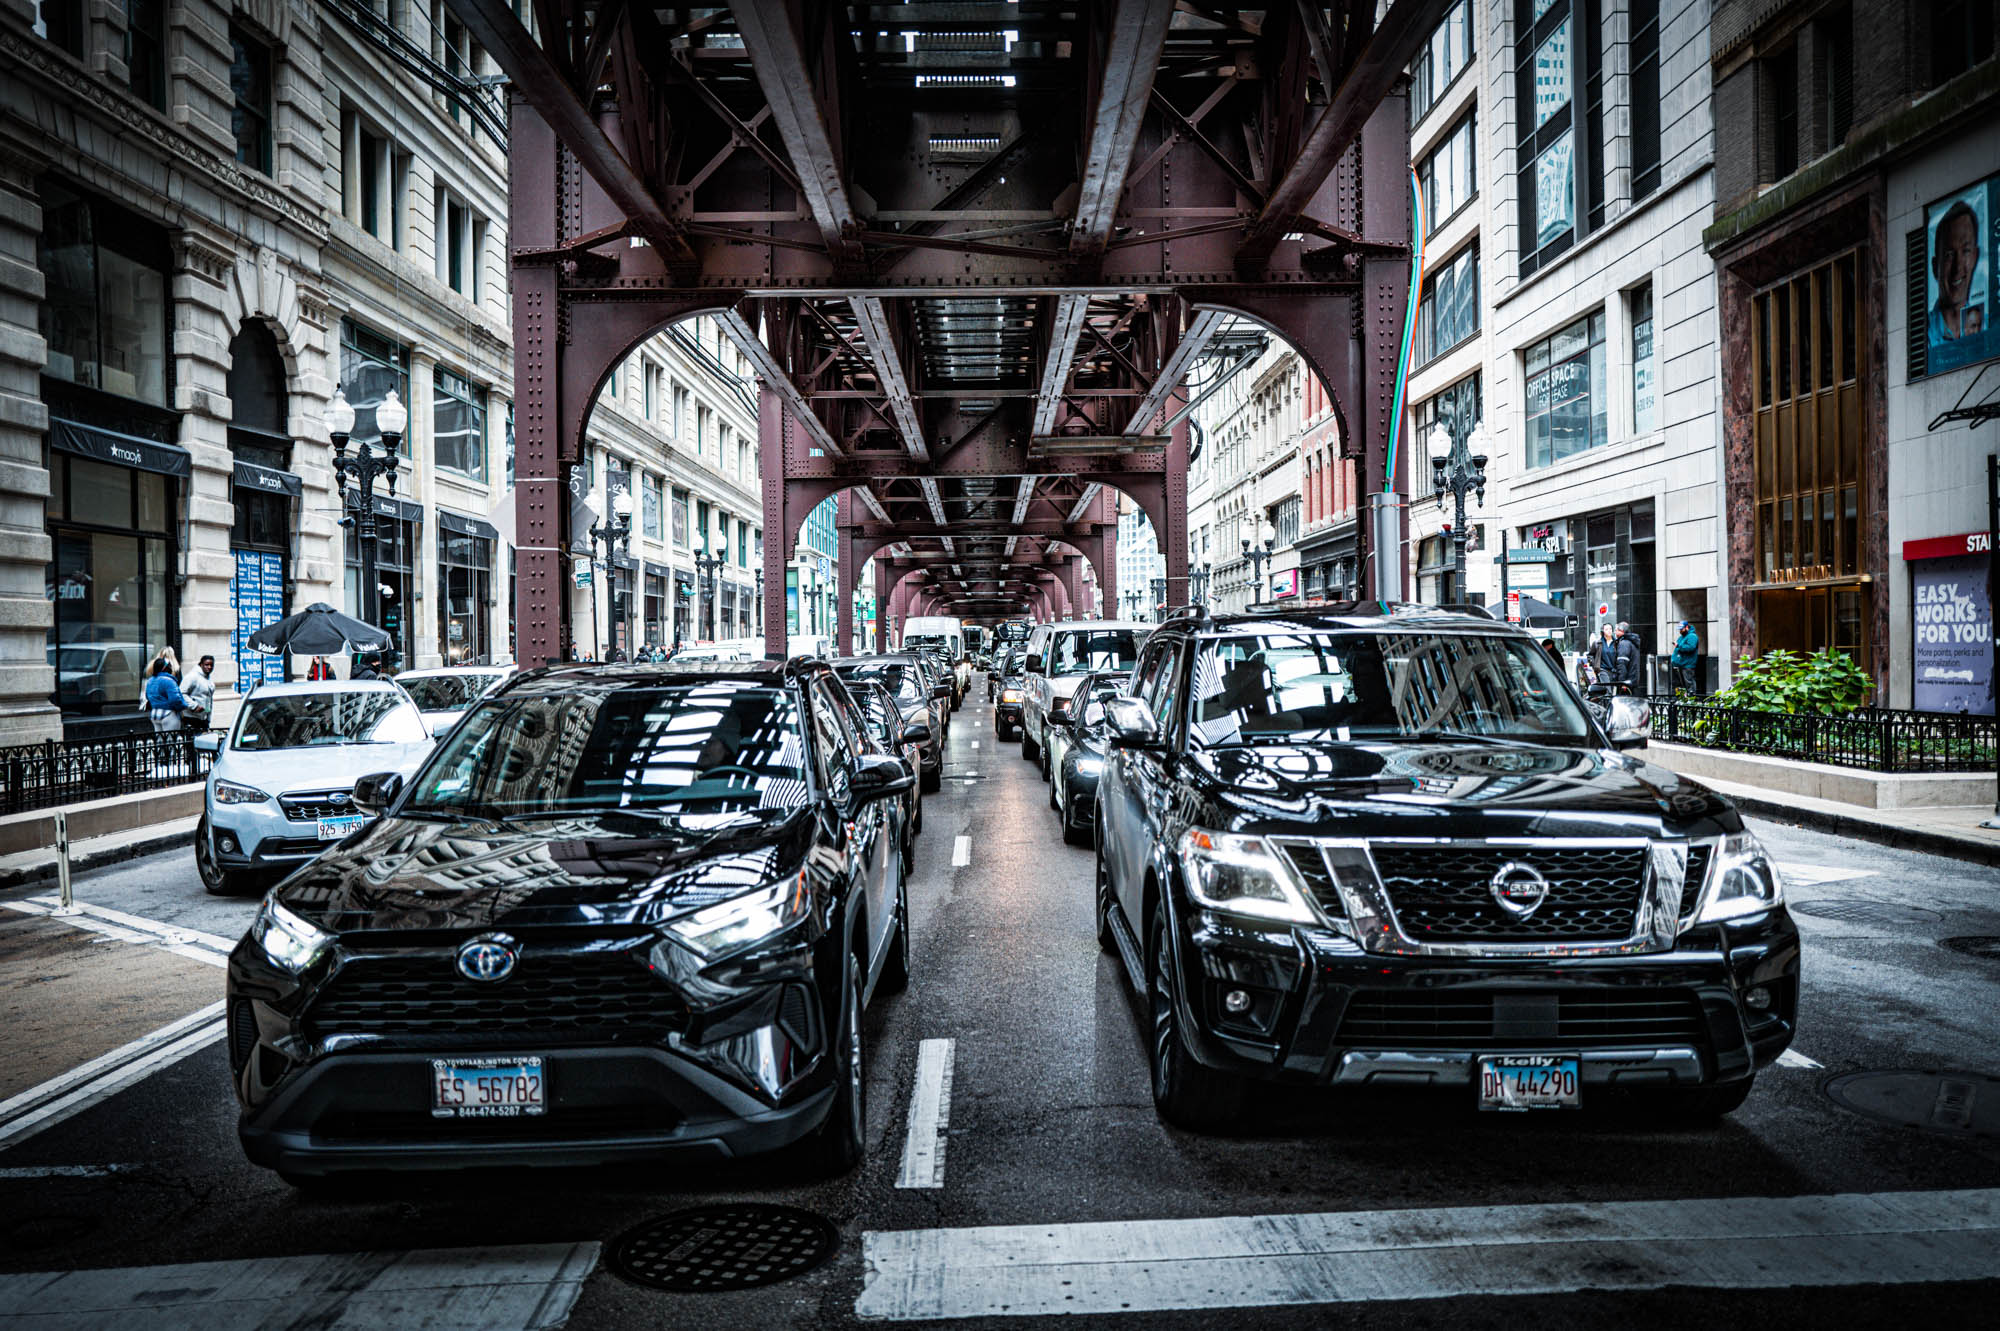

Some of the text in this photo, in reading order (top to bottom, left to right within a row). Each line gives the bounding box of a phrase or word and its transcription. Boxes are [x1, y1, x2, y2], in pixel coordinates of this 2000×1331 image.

[1526, 362, 1575, 399] OFFICE SPACE
[116, 449, 142, 465] macy's
[262, 476, 282, 489] macy's
[1545, 535, 1561, 554] SPA
[1916, 583, 1959, 604] EASY
[1915, 602, 1977, 624] WORKS
[1917, 623, 1991, 643] FOR YOU.
[356, 642, 380, 652] Valet
[1917, 648, 1984, 658] More points, perks and
[319, 823, 336, 836] 925
[1503, 1056, 1554, 1068] kelly
[440, 1075, 541, 1105] ES 56782
[1516, 1070, 1575, 1096] 44290
[459, 1105, 521, 1118] 844-474-5287
